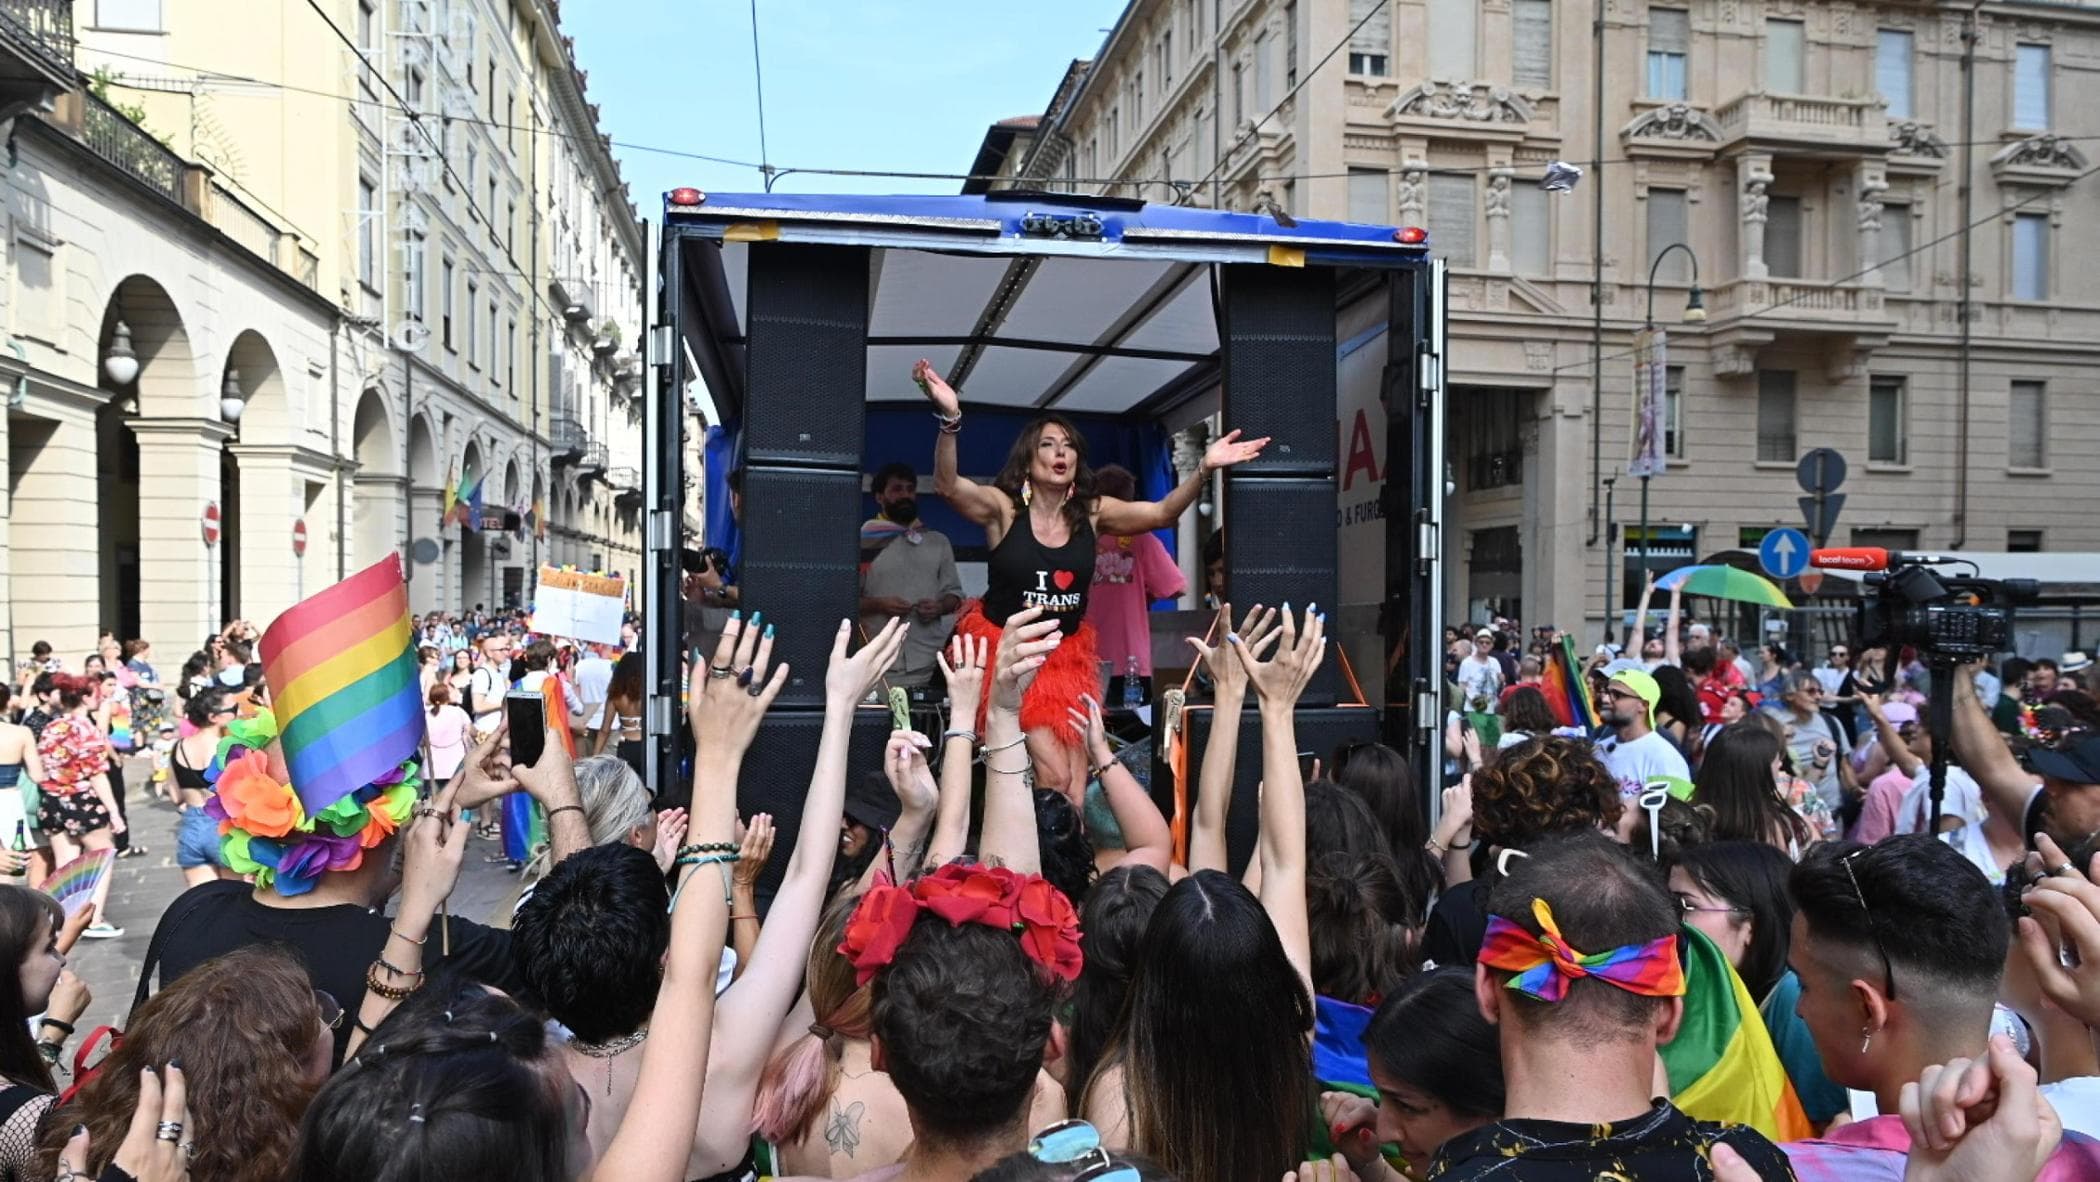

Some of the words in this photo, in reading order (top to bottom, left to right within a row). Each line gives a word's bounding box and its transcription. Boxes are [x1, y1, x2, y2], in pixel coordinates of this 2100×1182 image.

[1345, 506, 1352, 526] &
[1035, 570, 1048, 591] I
[1023, 590, 1081, 606] TRANS
